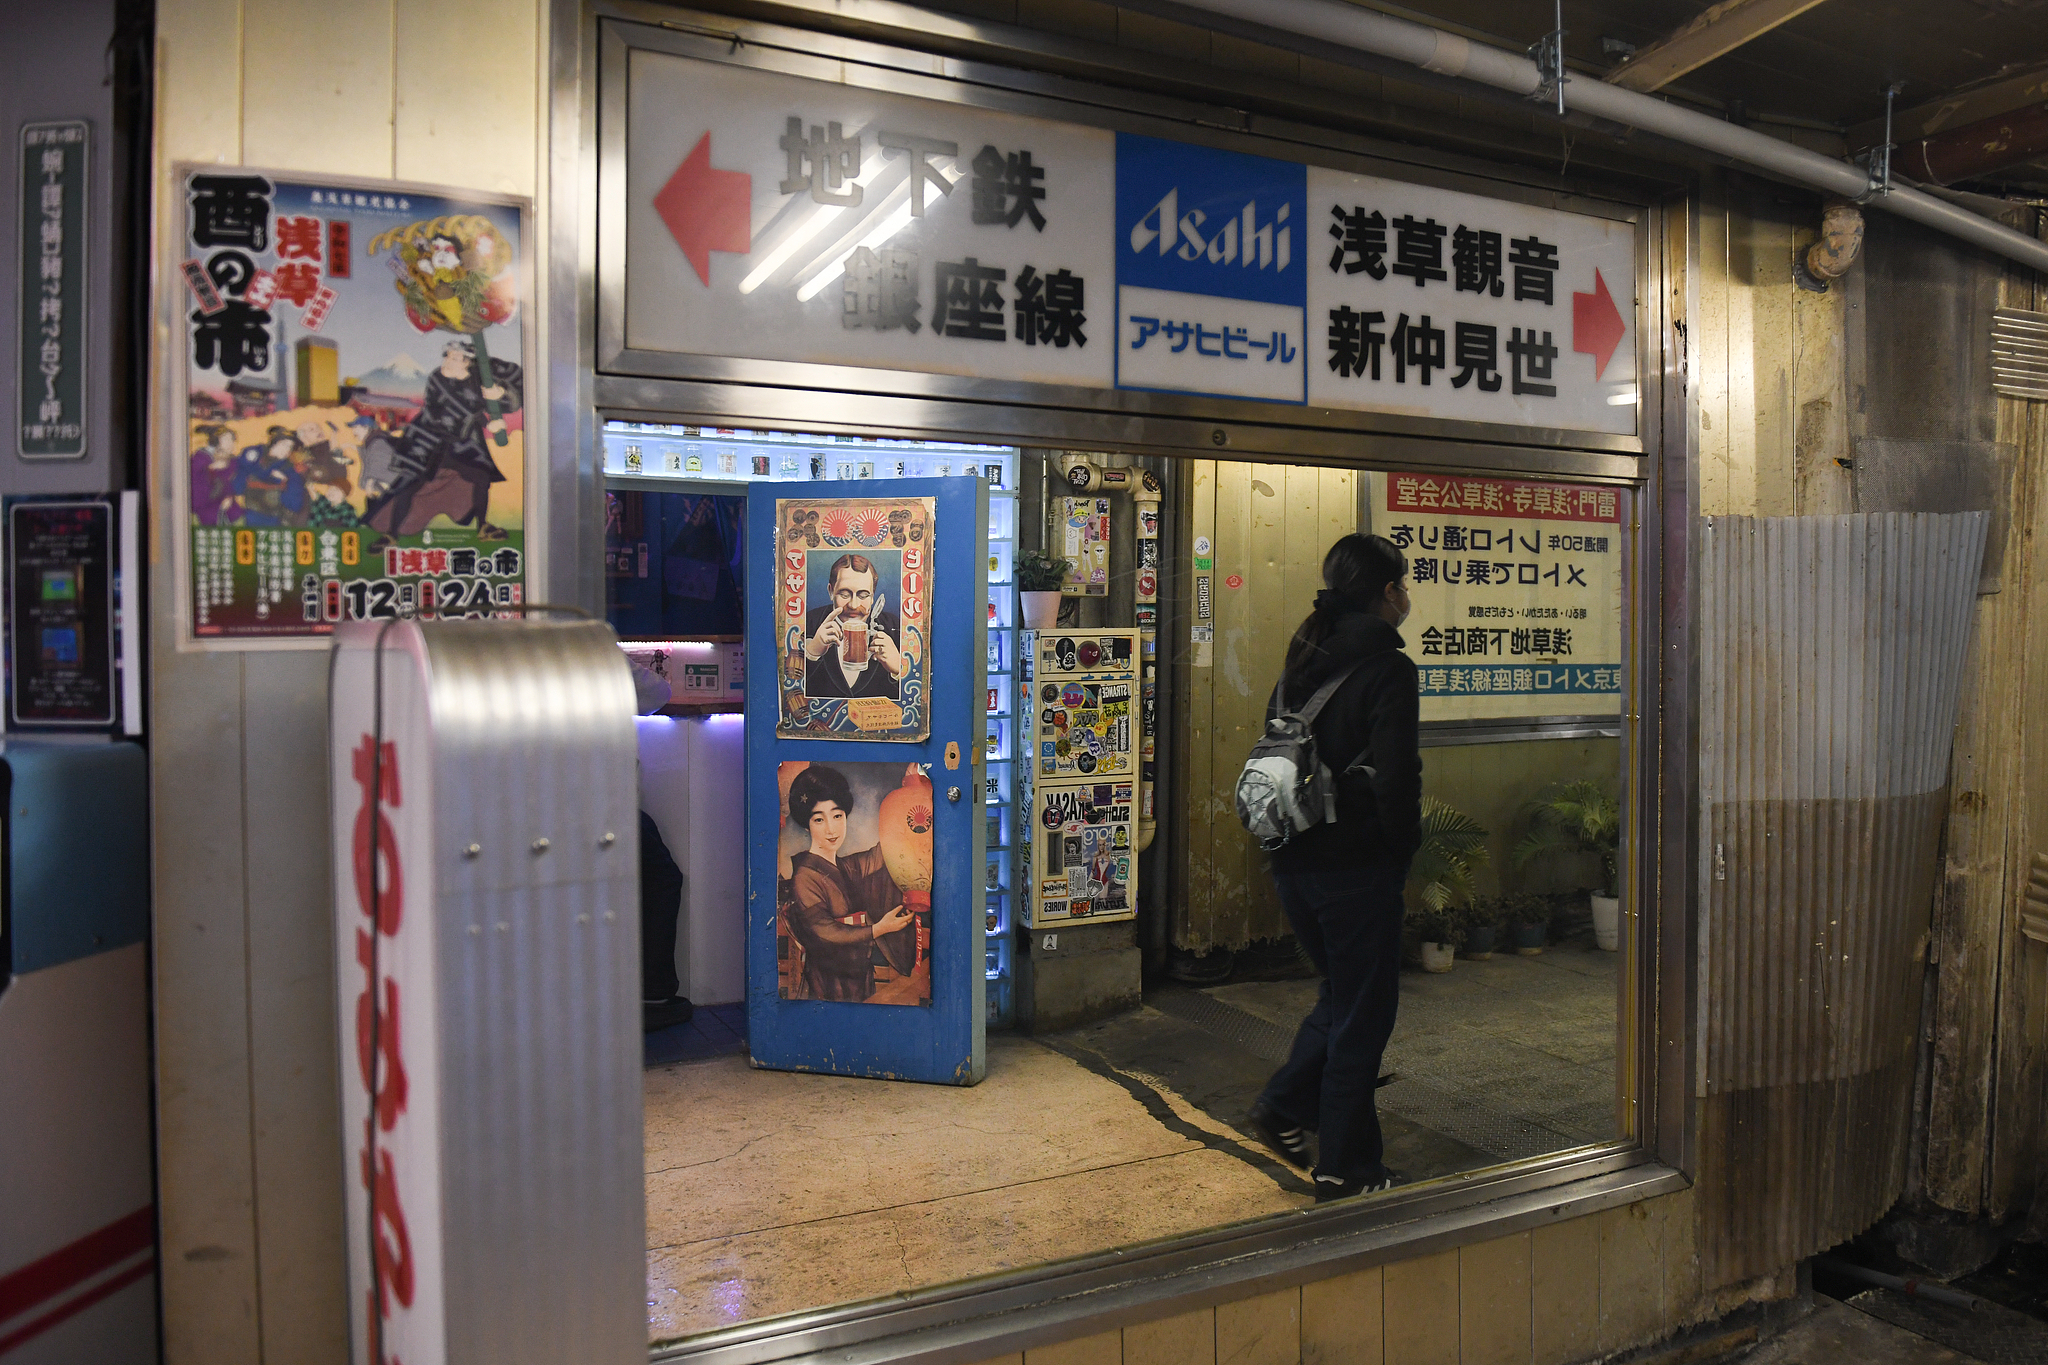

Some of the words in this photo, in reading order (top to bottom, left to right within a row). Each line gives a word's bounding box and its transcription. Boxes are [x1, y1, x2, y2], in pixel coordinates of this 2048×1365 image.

[779, 116, 1047, 233] 地下鉄
[276, 216, 323, 308] 浅草
[1129, 186, 1291, 273] Asahi
[1328, 203, 1560, 306] 浅草観音
[189, 175, 273, 378] 酉の市
[841, 244, 1088, 349] 銀座線
[1129, 315, 1297, 364] アサヒビール
[1327, 305, 1559, 399] 新仲見世
[345, 579, 399, 619] 12
[440, 580, 495, 619] 24
